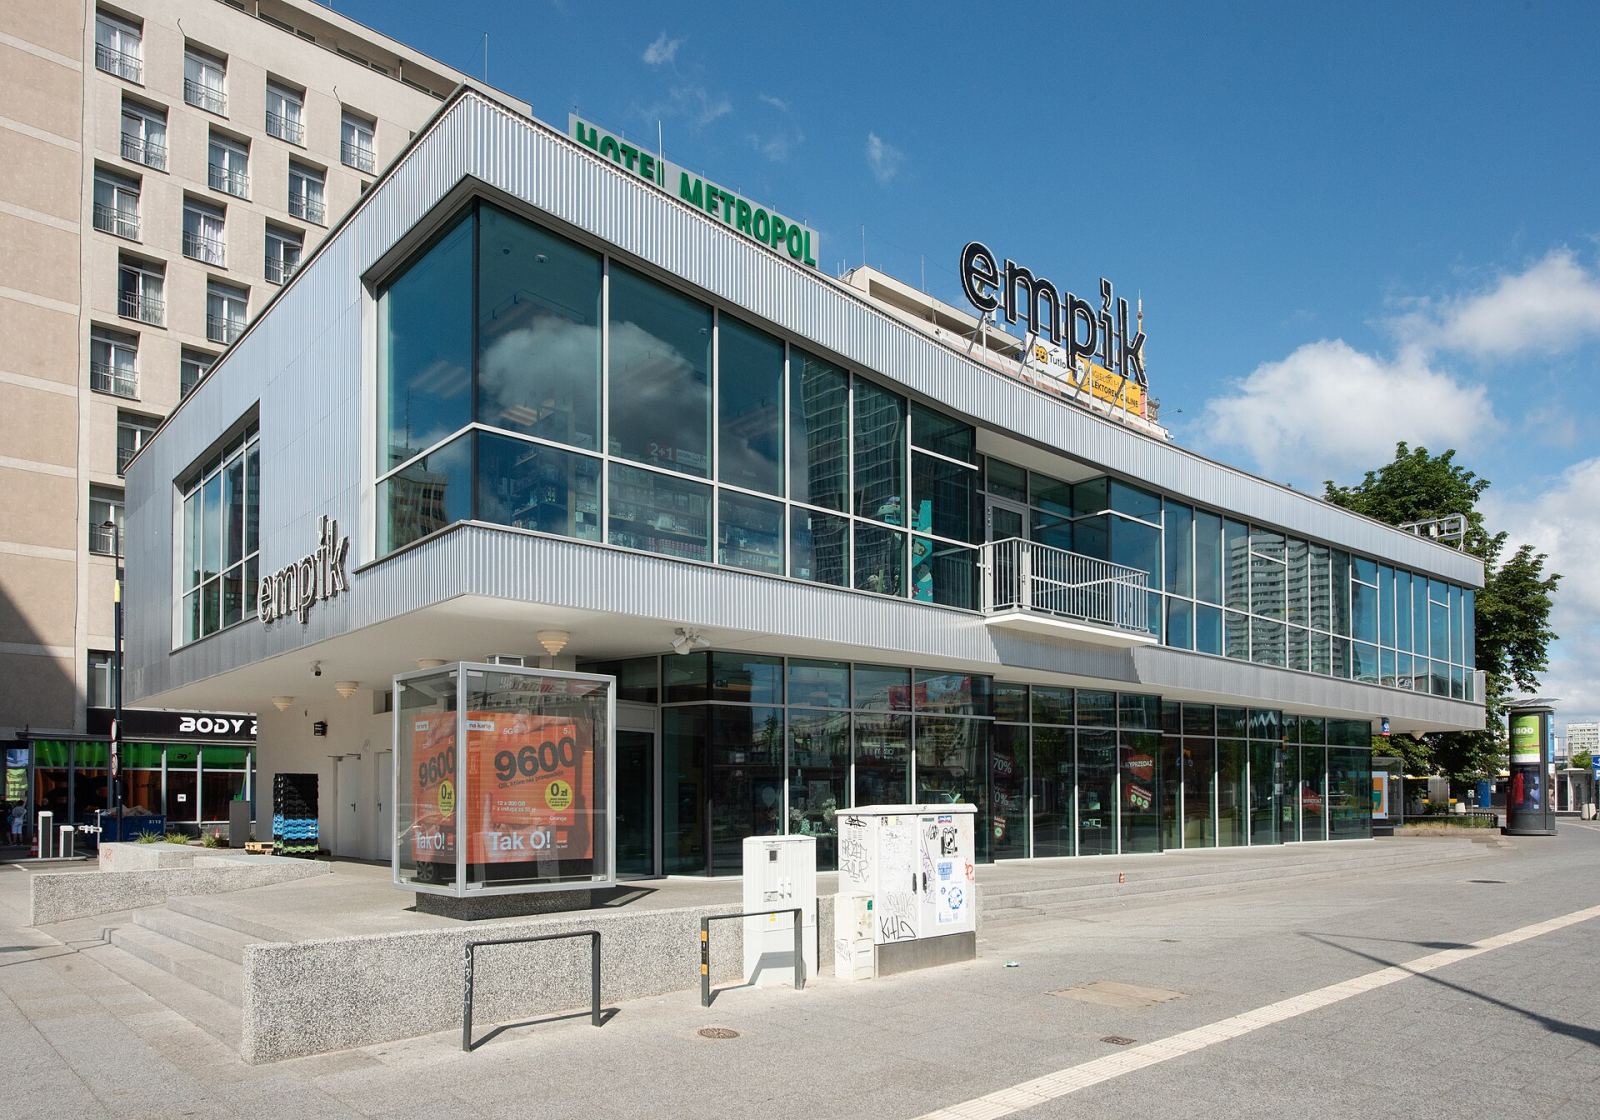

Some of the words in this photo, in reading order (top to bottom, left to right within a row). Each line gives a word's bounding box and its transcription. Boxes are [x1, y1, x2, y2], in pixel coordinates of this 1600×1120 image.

[679, 171, 816, 266] METROPOL
[960, 241, 1148, 388] empik
[258, 515, 349, 624] empik
[180, 716, 245, 734] BODY
[418, 746, 456, 787] 9600
[494, 736, 576, 781] 9600
[551, 782, 560, 797] 0
[488, 831, 525, 851] Tak
[530, 831, 551, 849] O!
